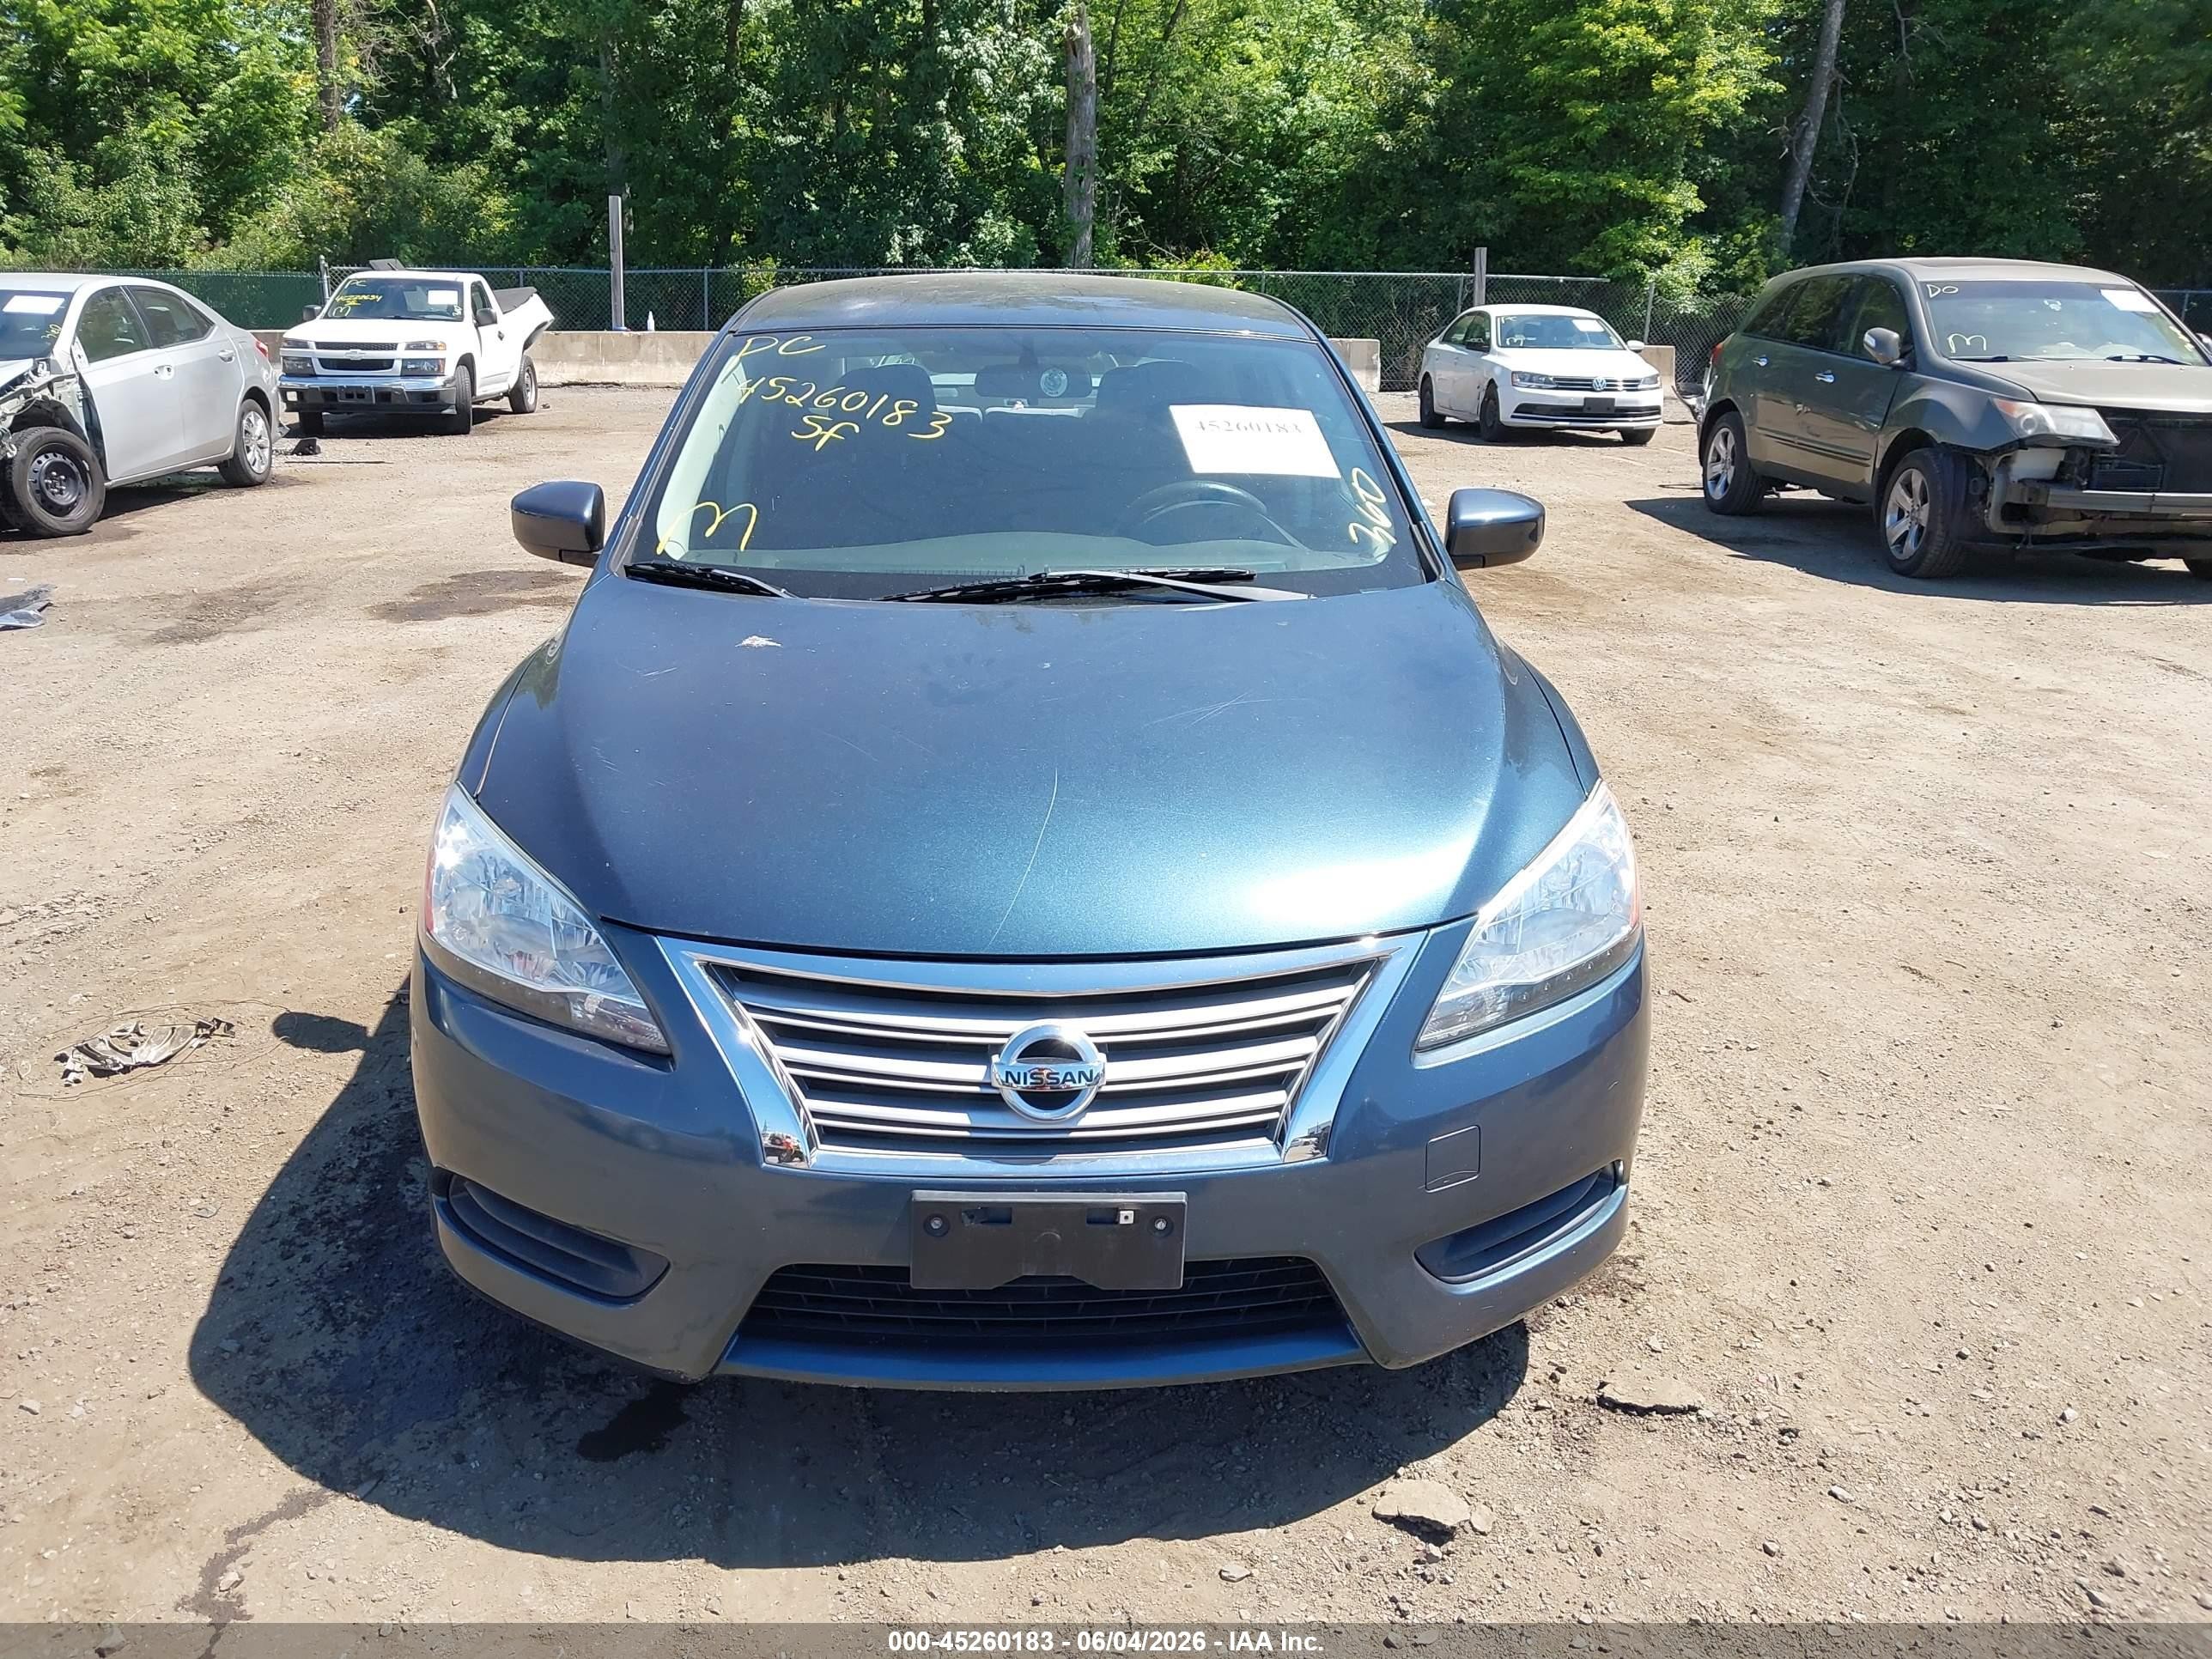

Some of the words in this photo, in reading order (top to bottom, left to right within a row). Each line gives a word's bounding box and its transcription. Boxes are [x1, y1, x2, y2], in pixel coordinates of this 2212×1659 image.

[737, 376, 952, 440] 45260183
[1348, 467, 1397, 544] 360
[1005, 1068, 1094, 1085] NISSAN
